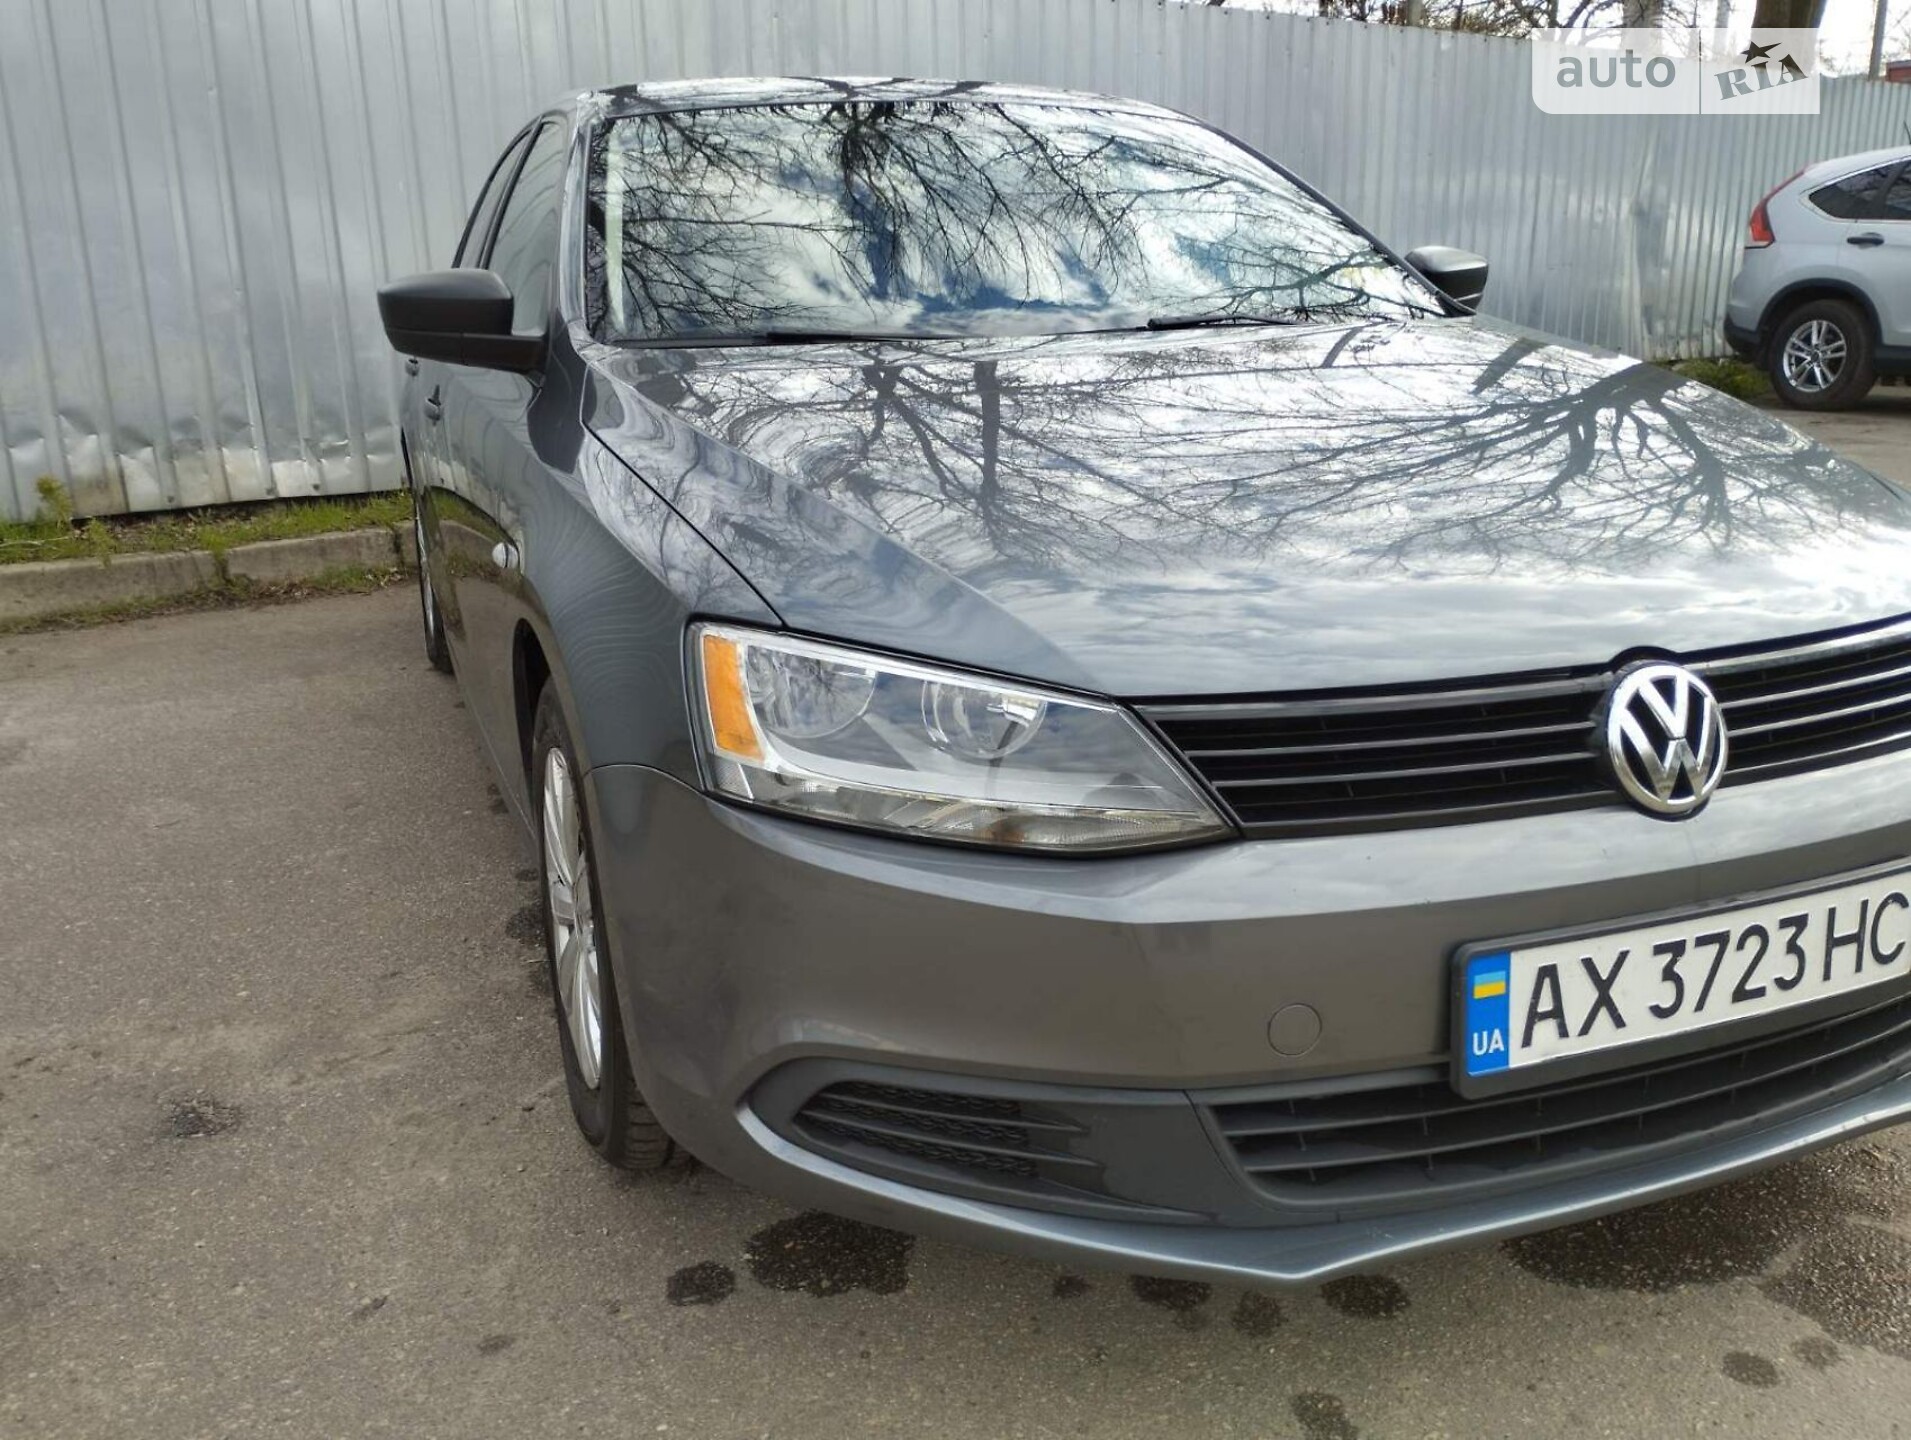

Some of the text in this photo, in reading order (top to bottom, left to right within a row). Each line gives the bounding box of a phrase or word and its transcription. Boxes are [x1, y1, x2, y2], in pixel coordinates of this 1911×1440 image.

[1520, 891, 1909, 1049] AX 3723 HC
[1472, 1028, 1505, 1056] UA
